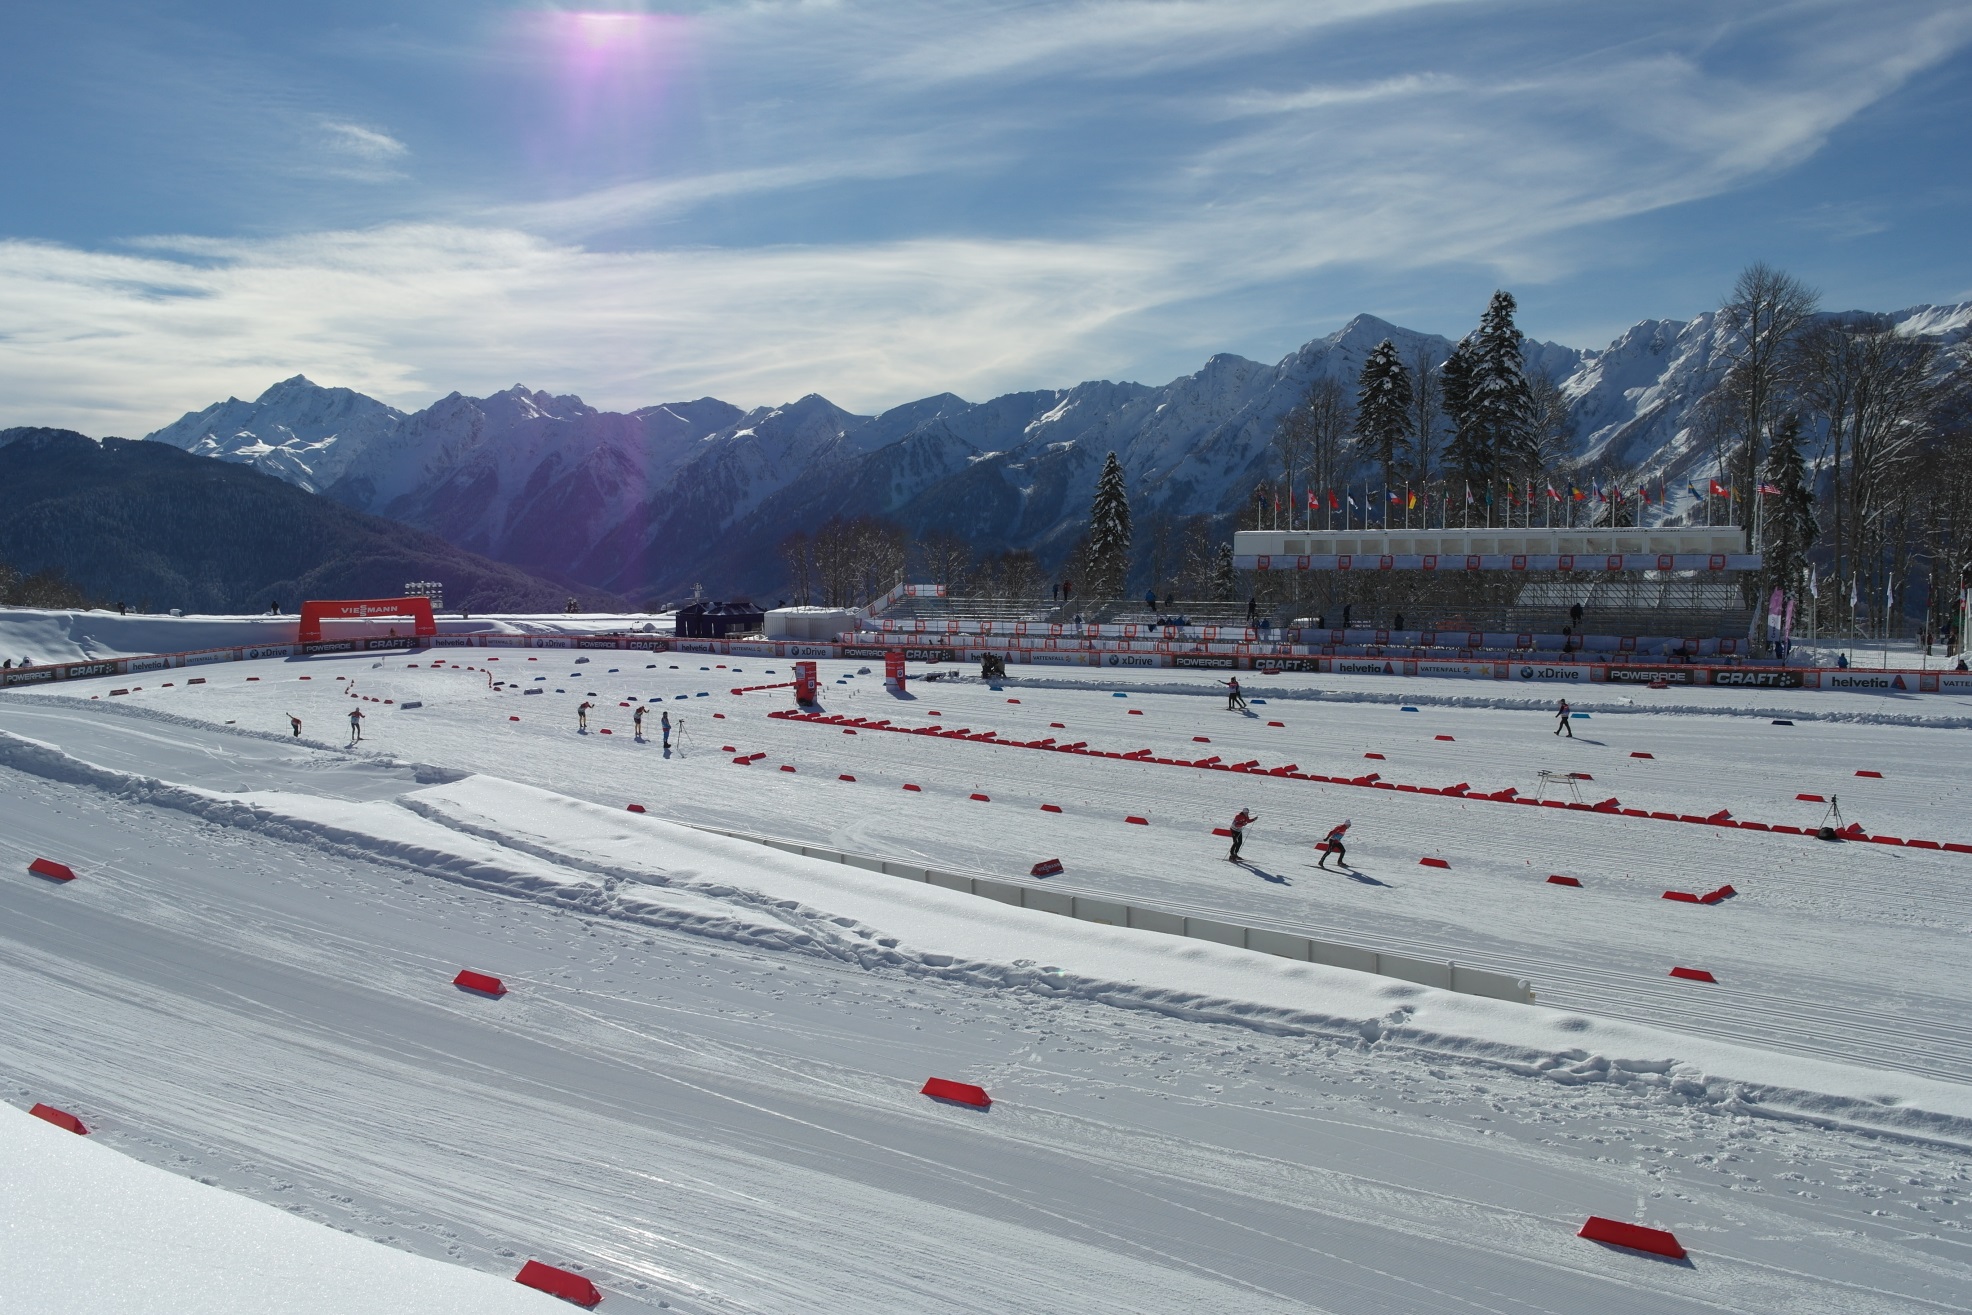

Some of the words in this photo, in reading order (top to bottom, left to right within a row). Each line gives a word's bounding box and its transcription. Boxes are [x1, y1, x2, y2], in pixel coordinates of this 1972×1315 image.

[341, 604, 398, 617] VIESSMANN
[306, 643, 351, 652] POWERADE
[369, 640, 405, 648] CRAFT
[545, 638, 566, 648] xDrive
[580, 641, 616, 649] POWERADE
[630, 641, 658, 650] CRAFT
[681, 644, 707, 652] helvetia
[261, 648, 287, 657] xDrive
[801, 647, 826, 656] xDrive
[906, 650, 941, 660] CRAFT
[132, 660, 162, 671] helvetia
[1121, 655, 1153, 666] xDrive
[1176, 658, 1233, 667] POWERADE
[1255, 659, 1301, 671] CRAFT
[70, 664, 105, 677] CRAFT
[1340, 663, 1381, 673] helvetia
[6, 671, 52, 683] POWERADE
[1538, 668, 1579, 679] xDrive
[1611, 671, 1686, 681] POWERADE
[1716, 672, 1778, 685] CRAFT
[1831, 676, 1889, 689] helvetia
